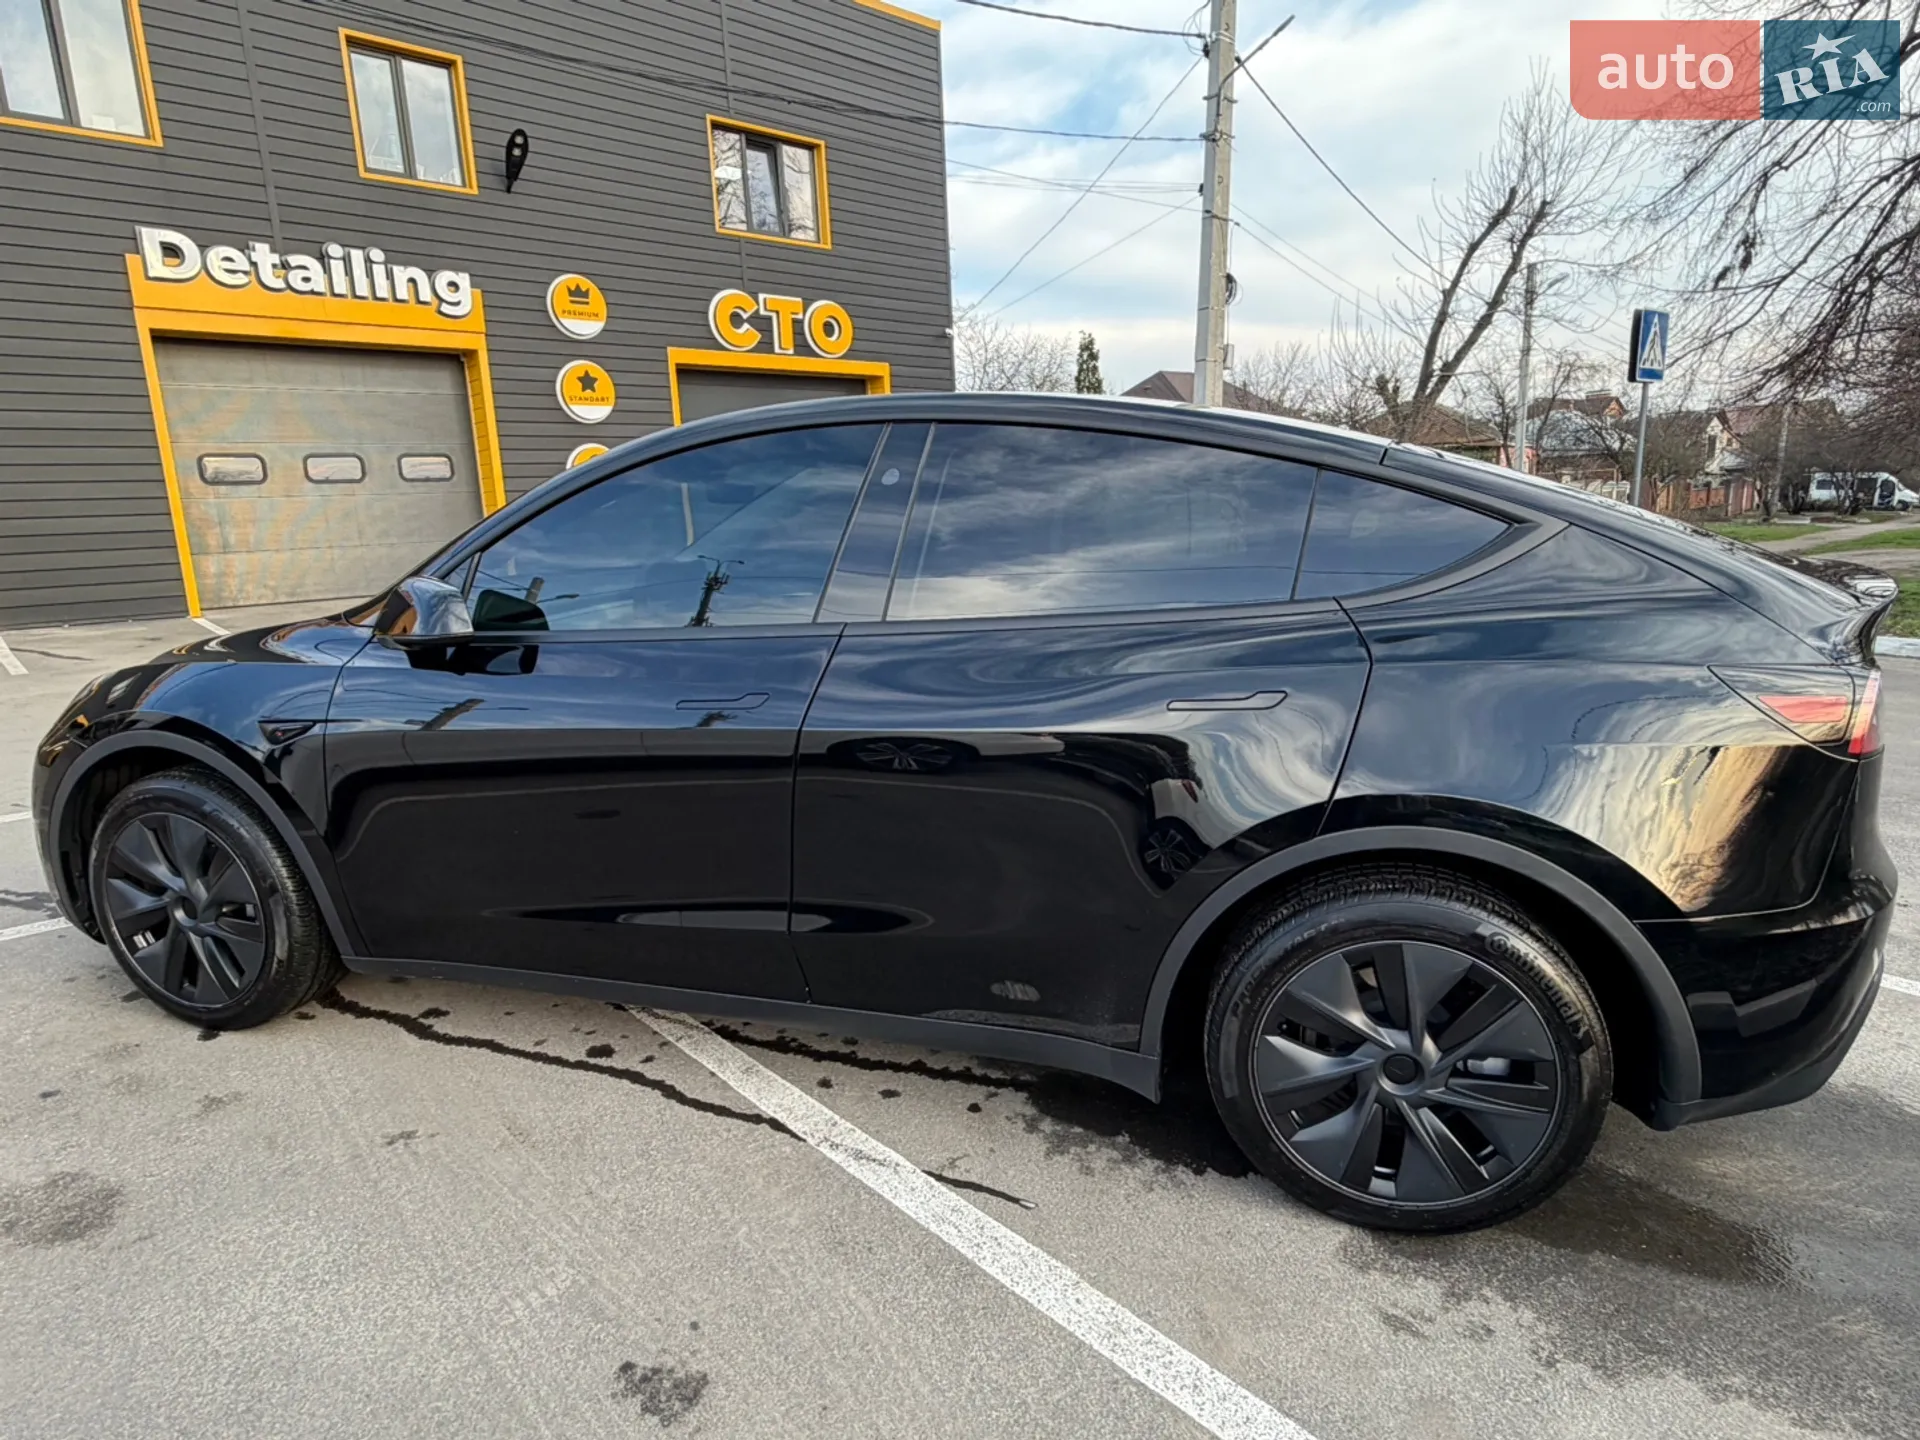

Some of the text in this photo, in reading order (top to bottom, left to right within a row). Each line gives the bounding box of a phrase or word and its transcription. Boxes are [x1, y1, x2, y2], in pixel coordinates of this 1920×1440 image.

[134, 225, 473, 318] Detailing
[561, 308, 600, 318] PREMIUM
[708, 288, 854, 358] СТО
[568, 395, 610, 403] STANDART
[1484, 931, 1584, 1024] Continental
